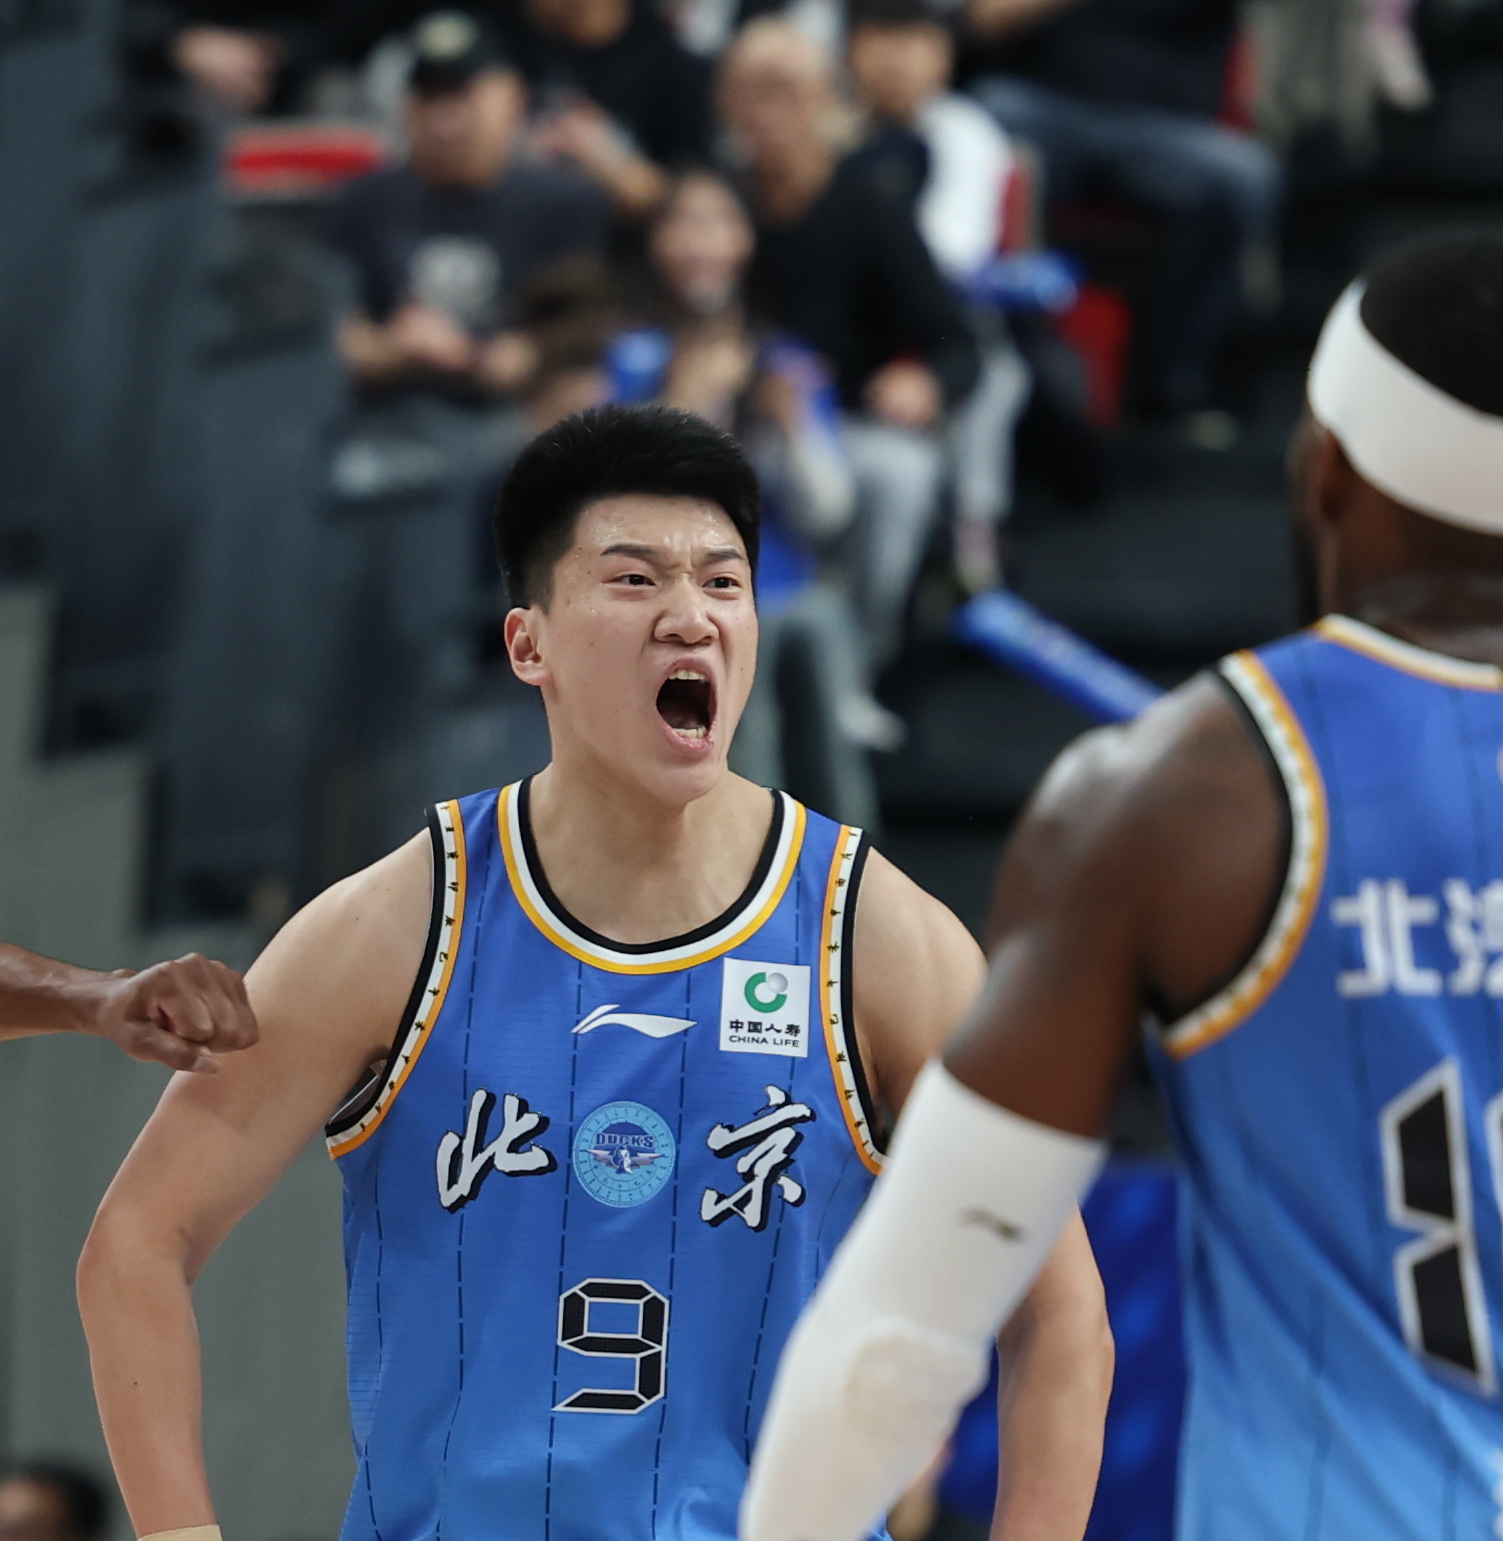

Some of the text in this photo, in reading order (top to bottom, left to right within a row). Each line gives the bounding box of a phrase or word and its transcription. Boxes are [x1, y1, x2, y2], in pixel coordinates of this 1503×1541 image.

[729, 1019, 801, 1038] 中国人寿
[728, 1034, 800, 1048] CHINA LIFE
[596, 1131, 655, 1150] DUCKS
[551, 1277, 669, 1415] 9
